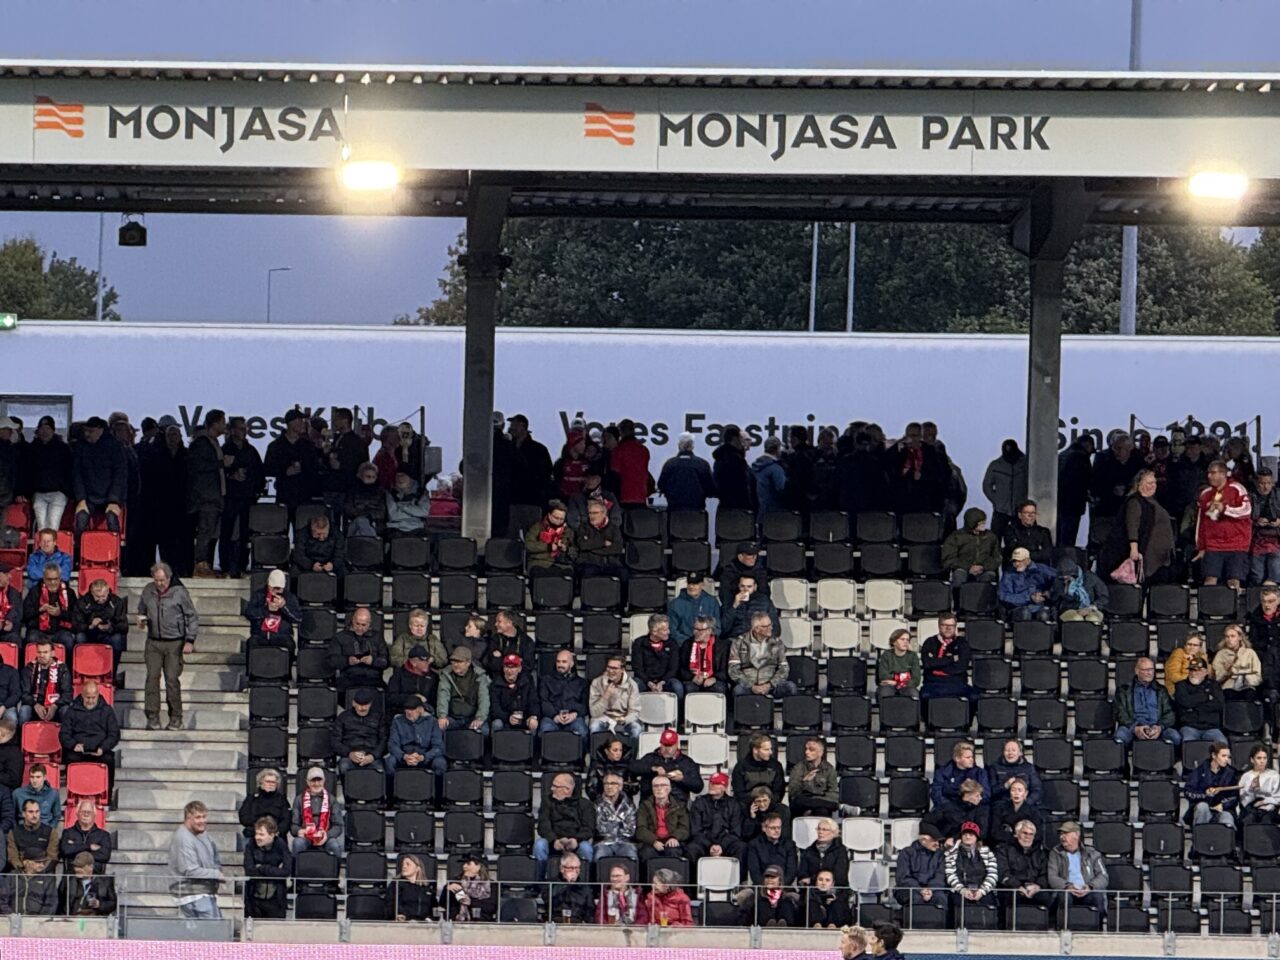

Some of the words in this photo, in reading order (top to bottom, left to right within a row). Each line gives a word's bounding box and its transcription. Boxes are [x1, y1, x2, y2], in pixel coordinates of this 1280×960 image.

[107, 104, 344, 152] MONJASA
[658, 112, 897, 161] MONJASA
[921, 115, 1051, 151] PARK
